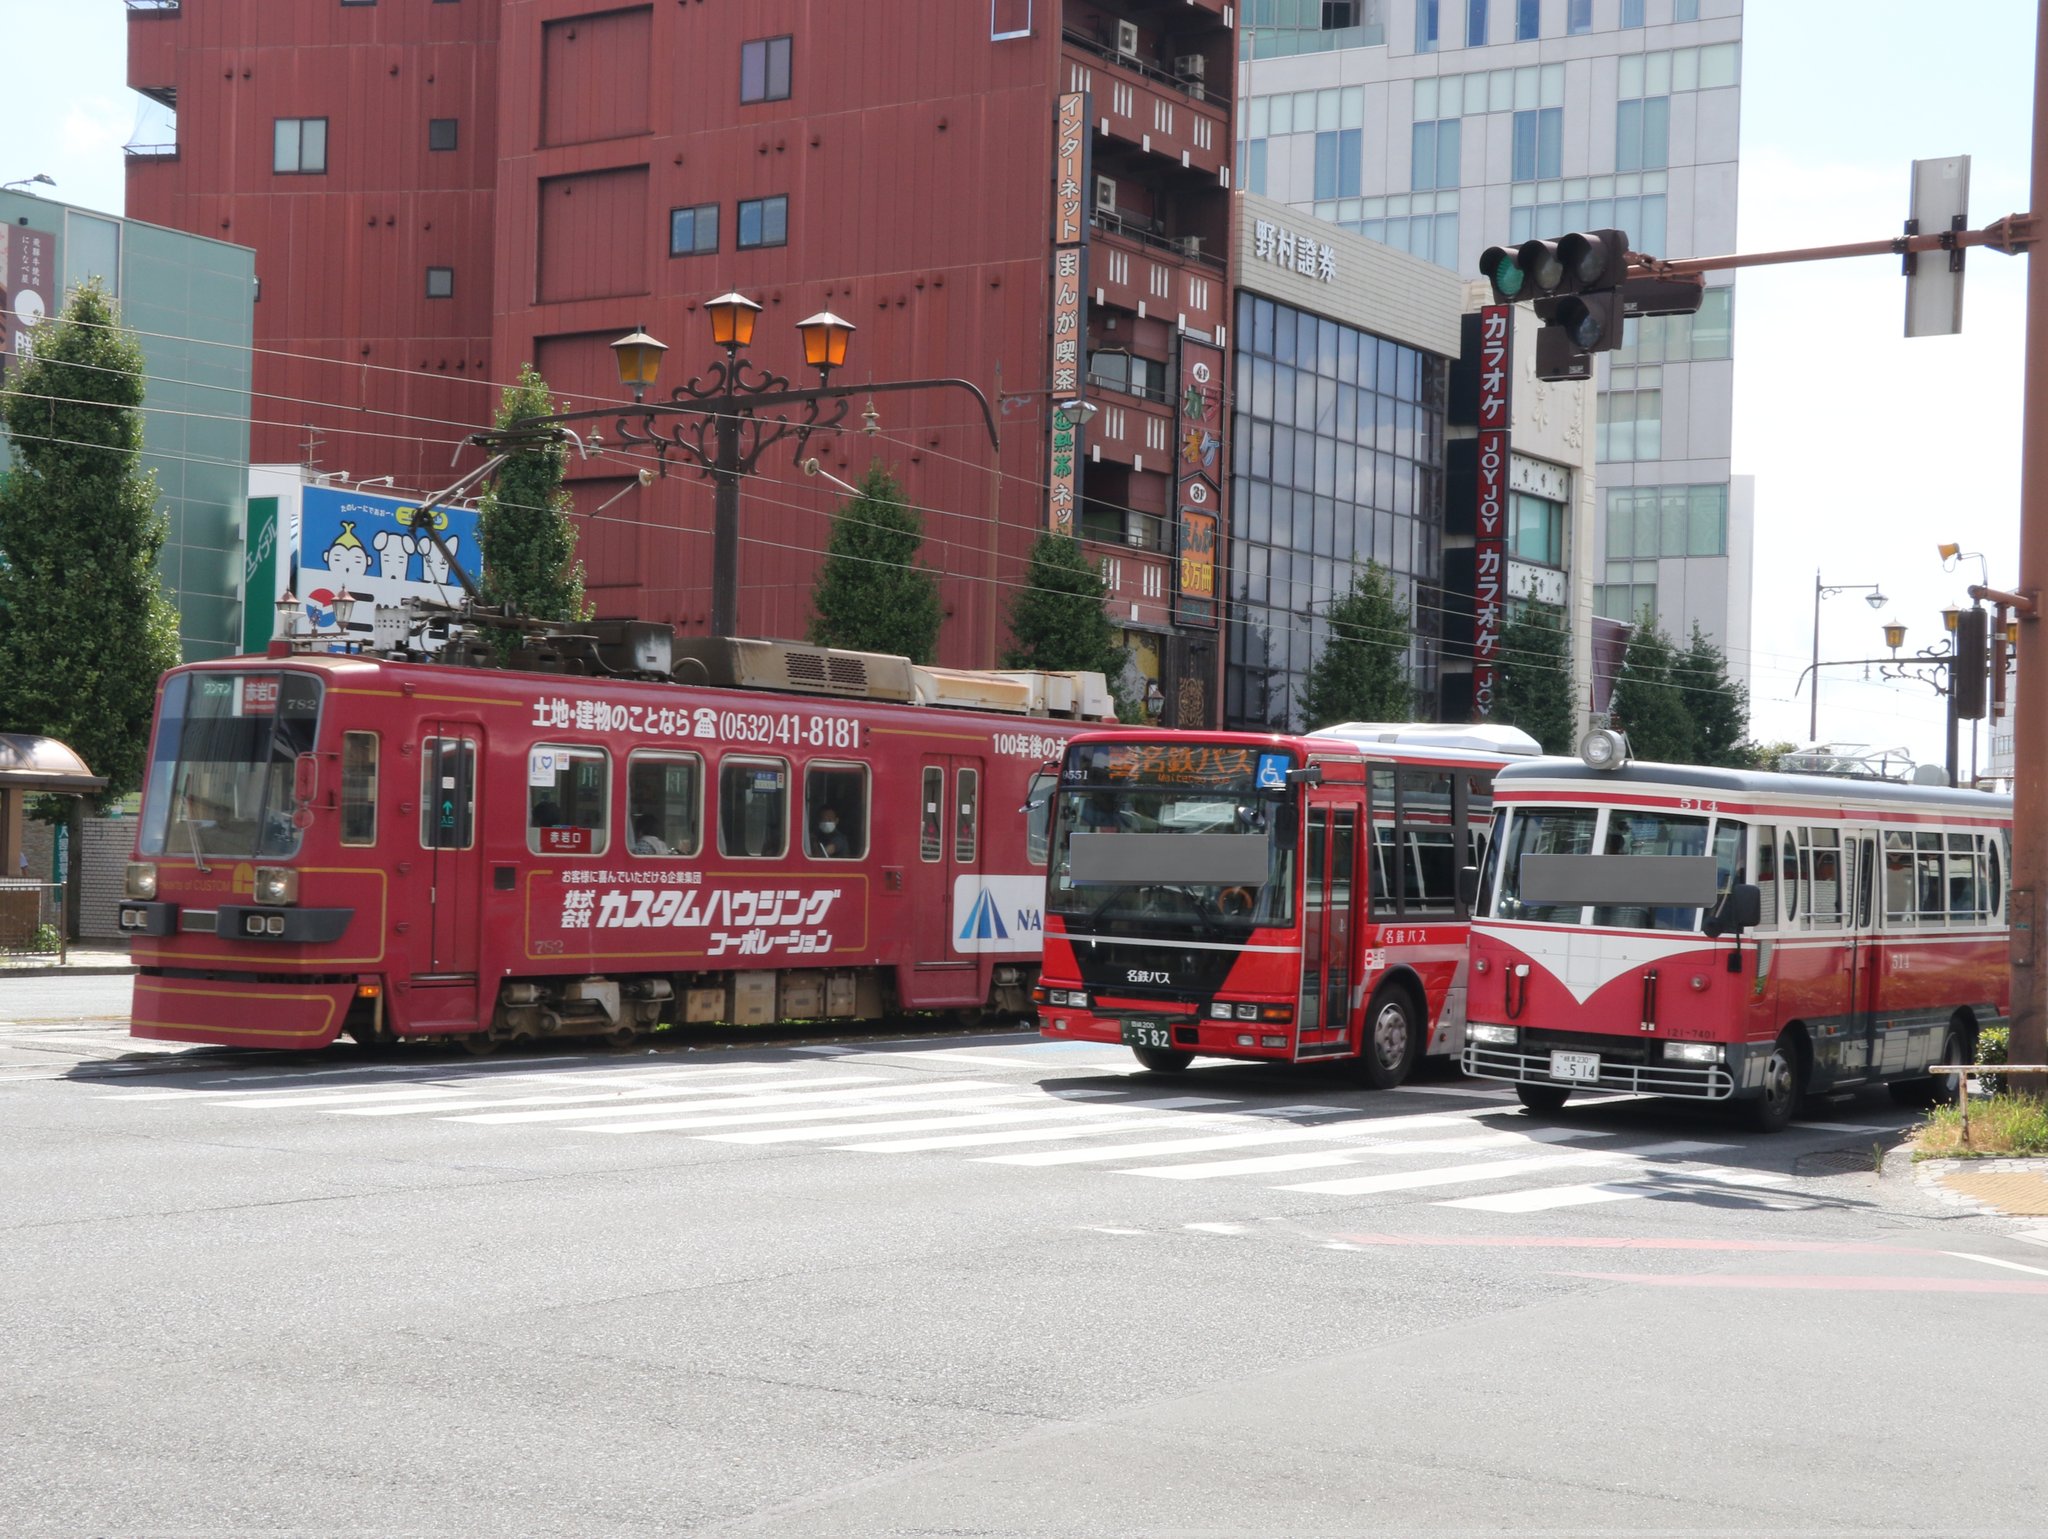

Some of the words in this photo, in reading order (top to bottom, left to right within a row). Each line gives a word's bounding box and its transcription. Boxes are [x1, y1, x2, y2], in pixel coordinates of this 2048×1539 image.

[1059, 95, 1082, 240] インターネット
[1255, 219, 1336, 283] 野村證券
[1055, 252, 1077, 391] まんが喫茶
[1481, 313, 1507, 420] カラオケ
[1480, 437, 1501, 533] JOYJOY
[246, 516, 278, 580] エイブル
[1181, 518, 1214, 555] まんが
[1181, 557, 1212, 592] 3万冊
[1476, 548, 1500, 655] カラオケ
[204, 682, 232, 695] ワンマン
[245, 682, 279, 702] 赤岩口
[287, 699, 317, 710] 782
[532, 697, 691, 737] 土地・建物のことなら
[719, 710, 860, 749] (0532)41-8181
[1680, 798, 1718, 812] 514
[550, 831, 581, 844] 赤岩口
[561, 870, 702, 885] お客様に喜んでいただける企業集団
[563, 889, 596, 909] 株式
[596, 888, 841, 928] カスタムハウジング
[534, 940, 564, 954] 782
[707, 928, 832, 956] コーポレーション
[1385, 929, 1426, 944] 名鉄バス
[1892, 953, 1909, 969] 514
[1126, 969, 1171, 985] 名鉄バス
[1666, 1029, 1717, 1039] 121-7401
